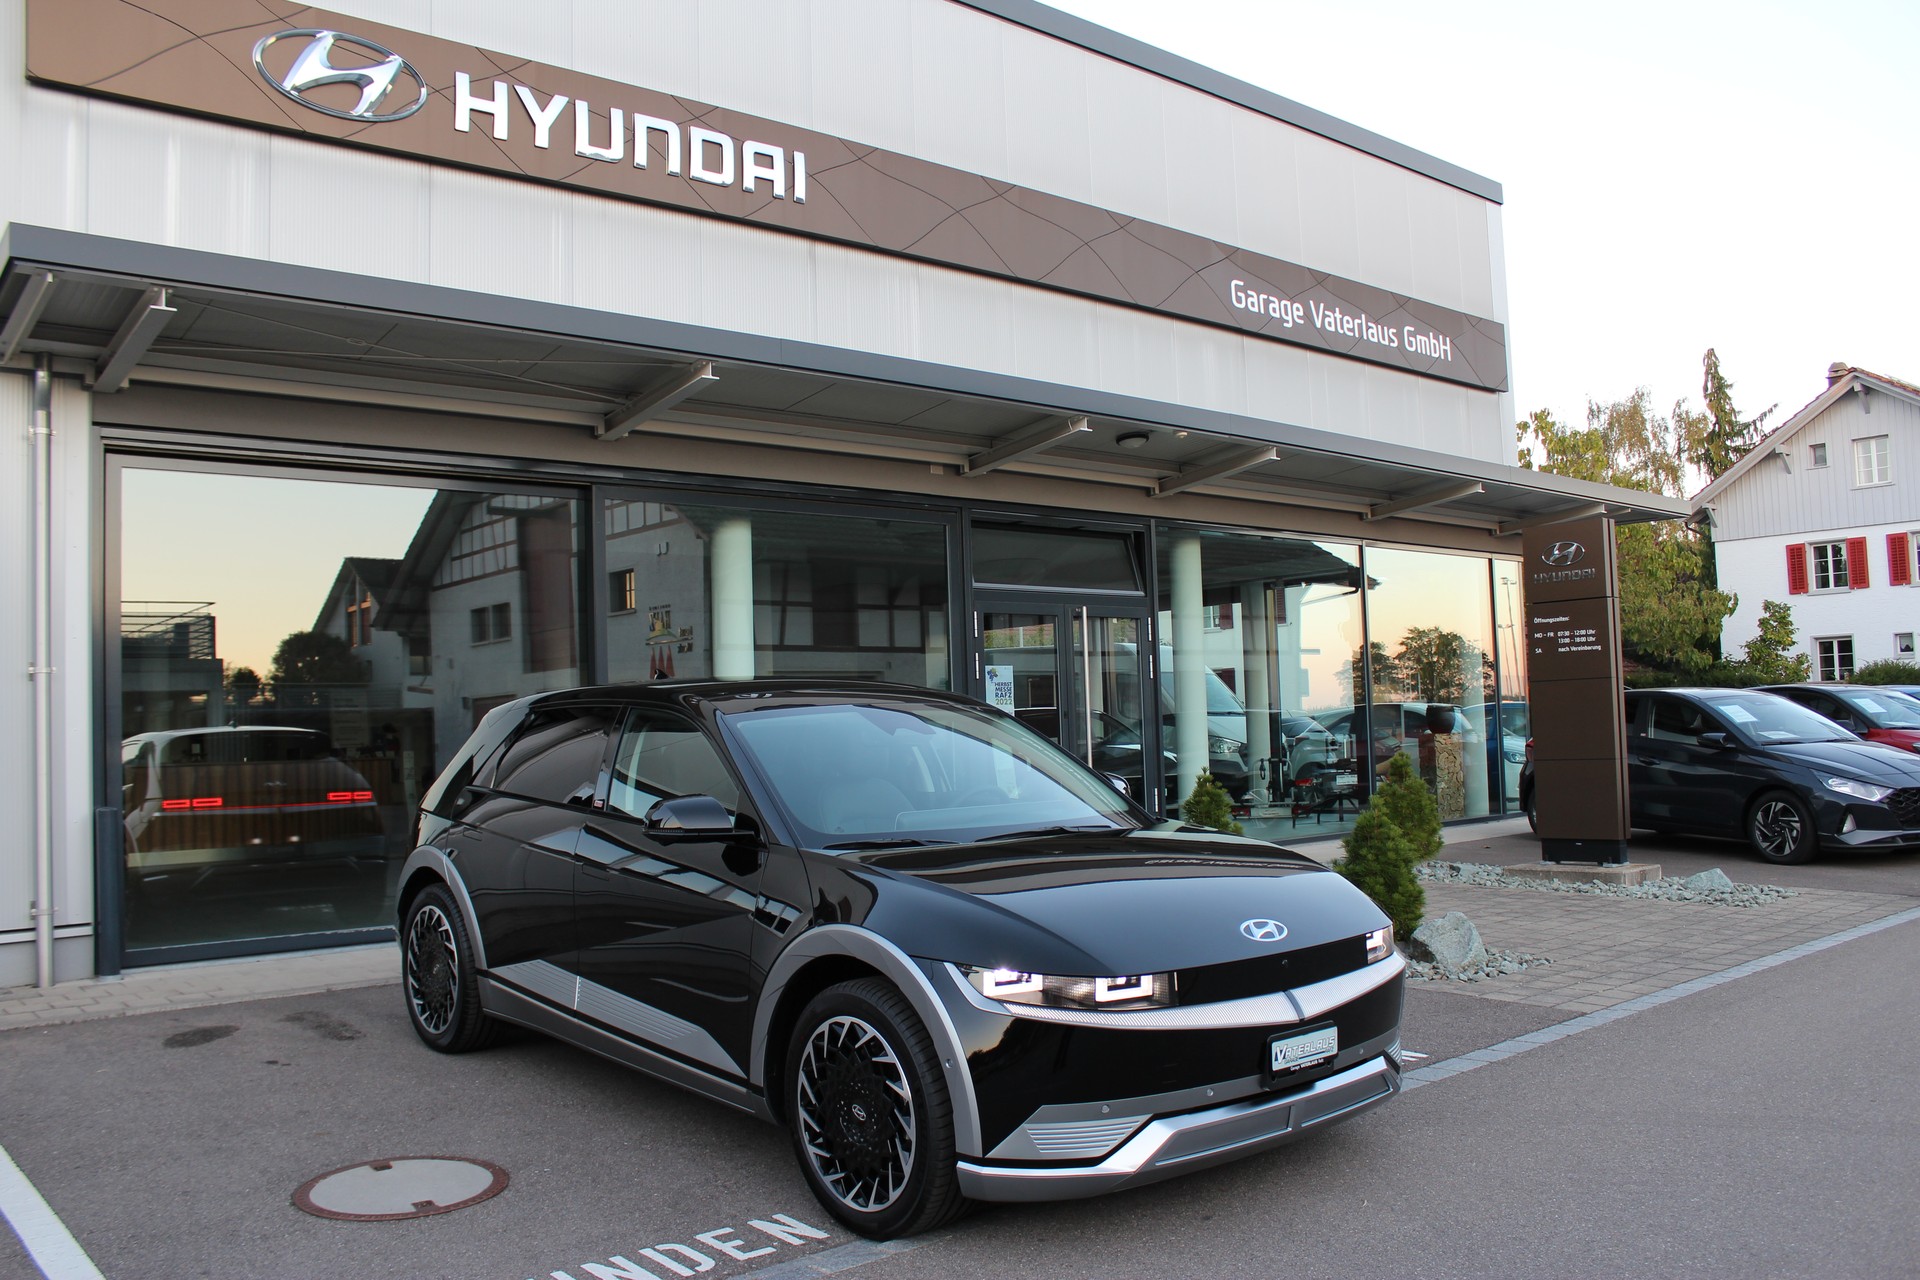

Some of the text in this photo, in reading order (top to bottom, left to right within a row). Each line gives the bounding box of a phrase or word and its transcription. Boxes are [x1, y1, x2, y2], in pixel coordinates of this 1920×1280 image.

[453, 71, 806, 204] HYUNDAI
[1230, 279, 1452, 361] Garage Vaterlaus GmbH
[1534, 568, 1596, 583] HYUNDAI
